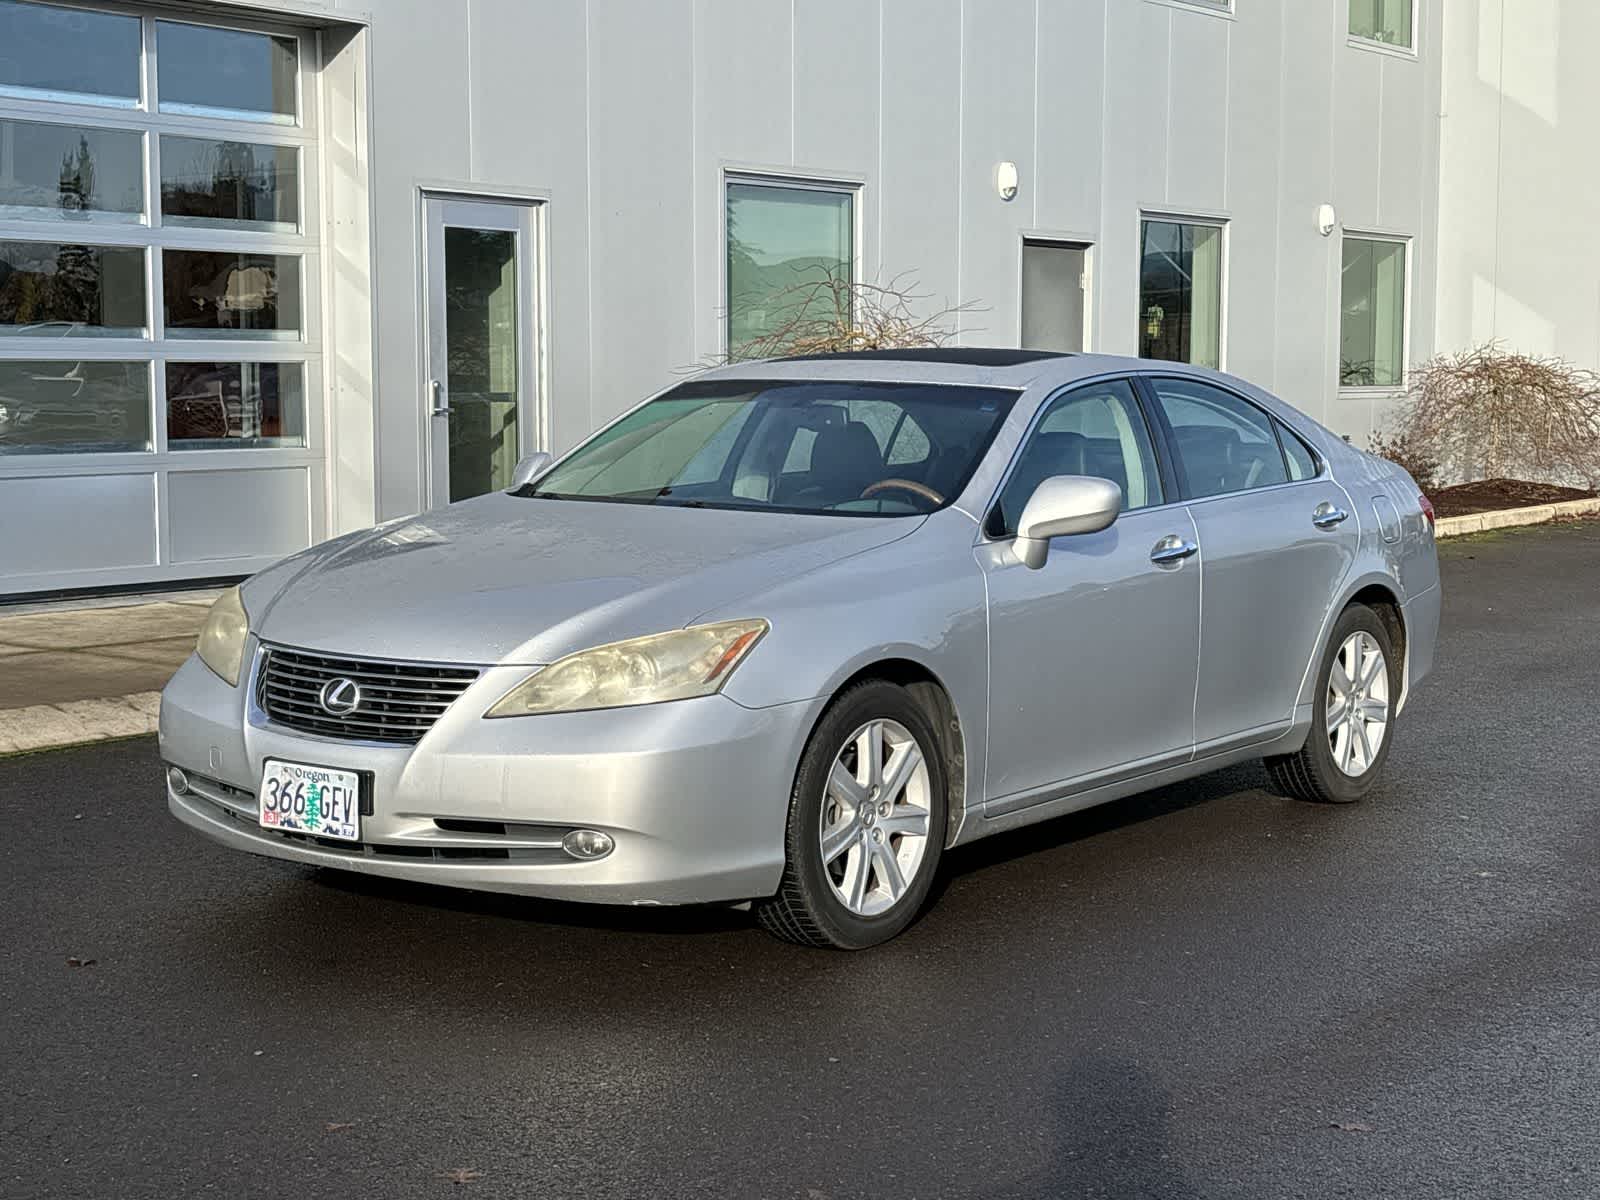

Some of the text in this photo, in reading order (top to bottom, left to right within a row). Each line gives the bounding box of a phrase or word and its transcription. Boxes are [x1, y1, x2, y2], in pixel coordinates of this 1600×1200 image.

[295, 767, 330, 783] Oregon
[266, 777, 353, 823] 366 GEV
